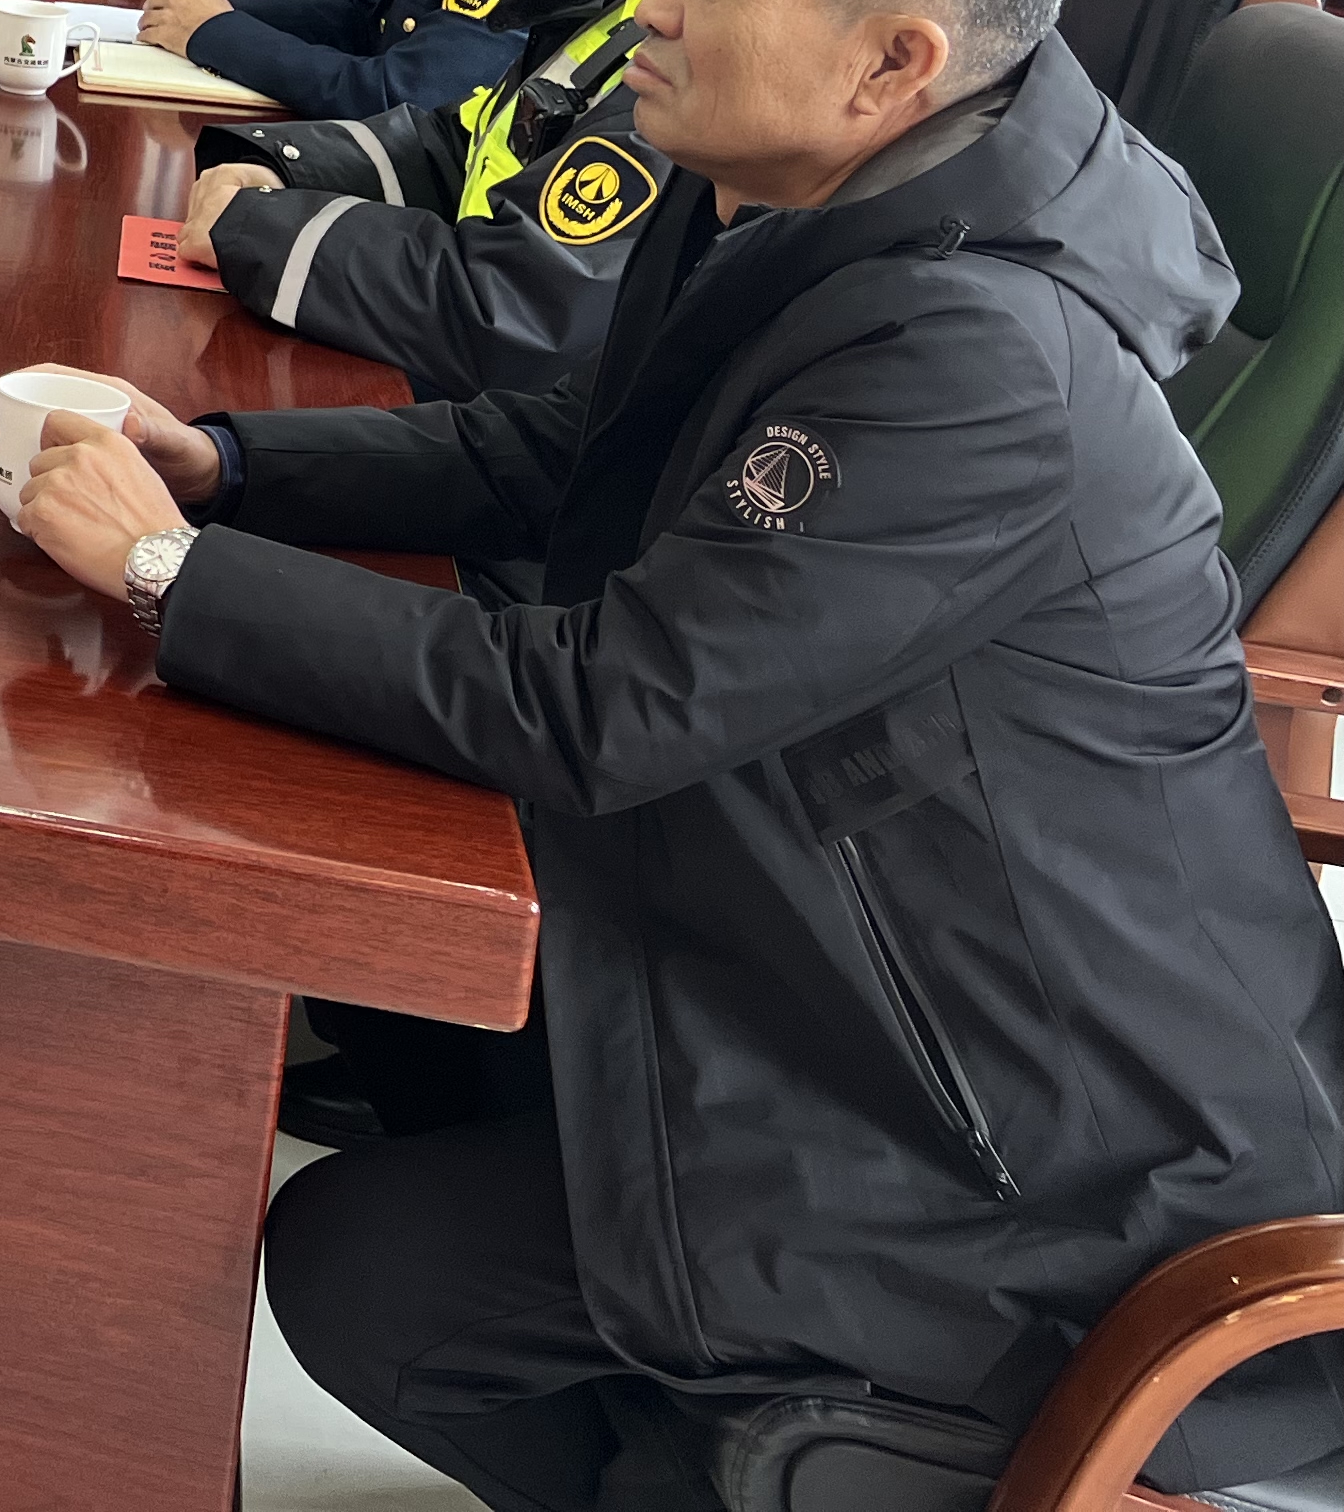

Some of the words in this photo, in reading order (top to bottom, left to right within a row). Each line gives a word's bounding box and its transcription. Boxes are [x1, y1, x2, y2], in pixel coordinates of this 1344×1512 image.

[560, 190, 598, 222] IMSH
[766, 425, 808, 446] DESIGN
[809, 443, 832, 481] STYLE
[726, 478, 786, 531] STYLISH
